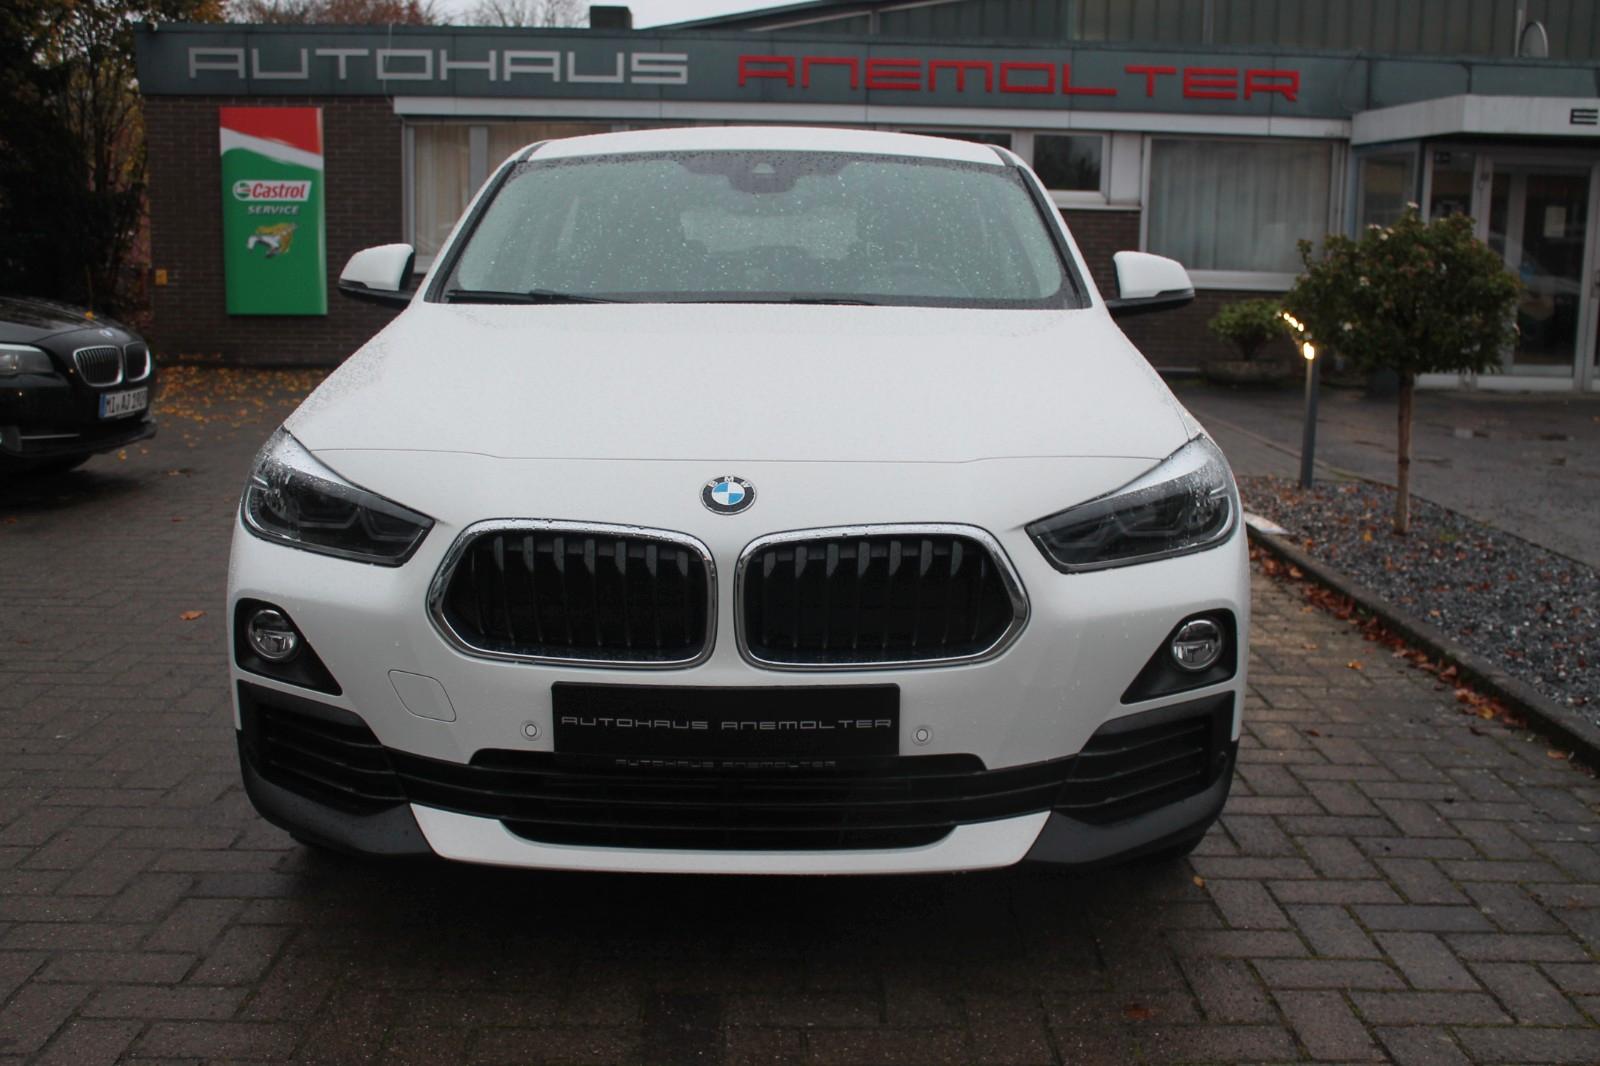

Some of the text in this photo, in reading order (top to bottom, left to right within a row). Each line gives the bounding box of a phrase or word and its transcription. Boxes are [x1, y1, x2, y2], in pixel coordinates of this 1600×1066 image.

[188, 47, 1299, 102] AUTOHAUS ANEMOLTER
[252, 182, 306, 199] Castrol
[247, 205, 299, 215] SERVICE
[561, 716, 893, 731] AUTOHAUS ANEMOLTER
